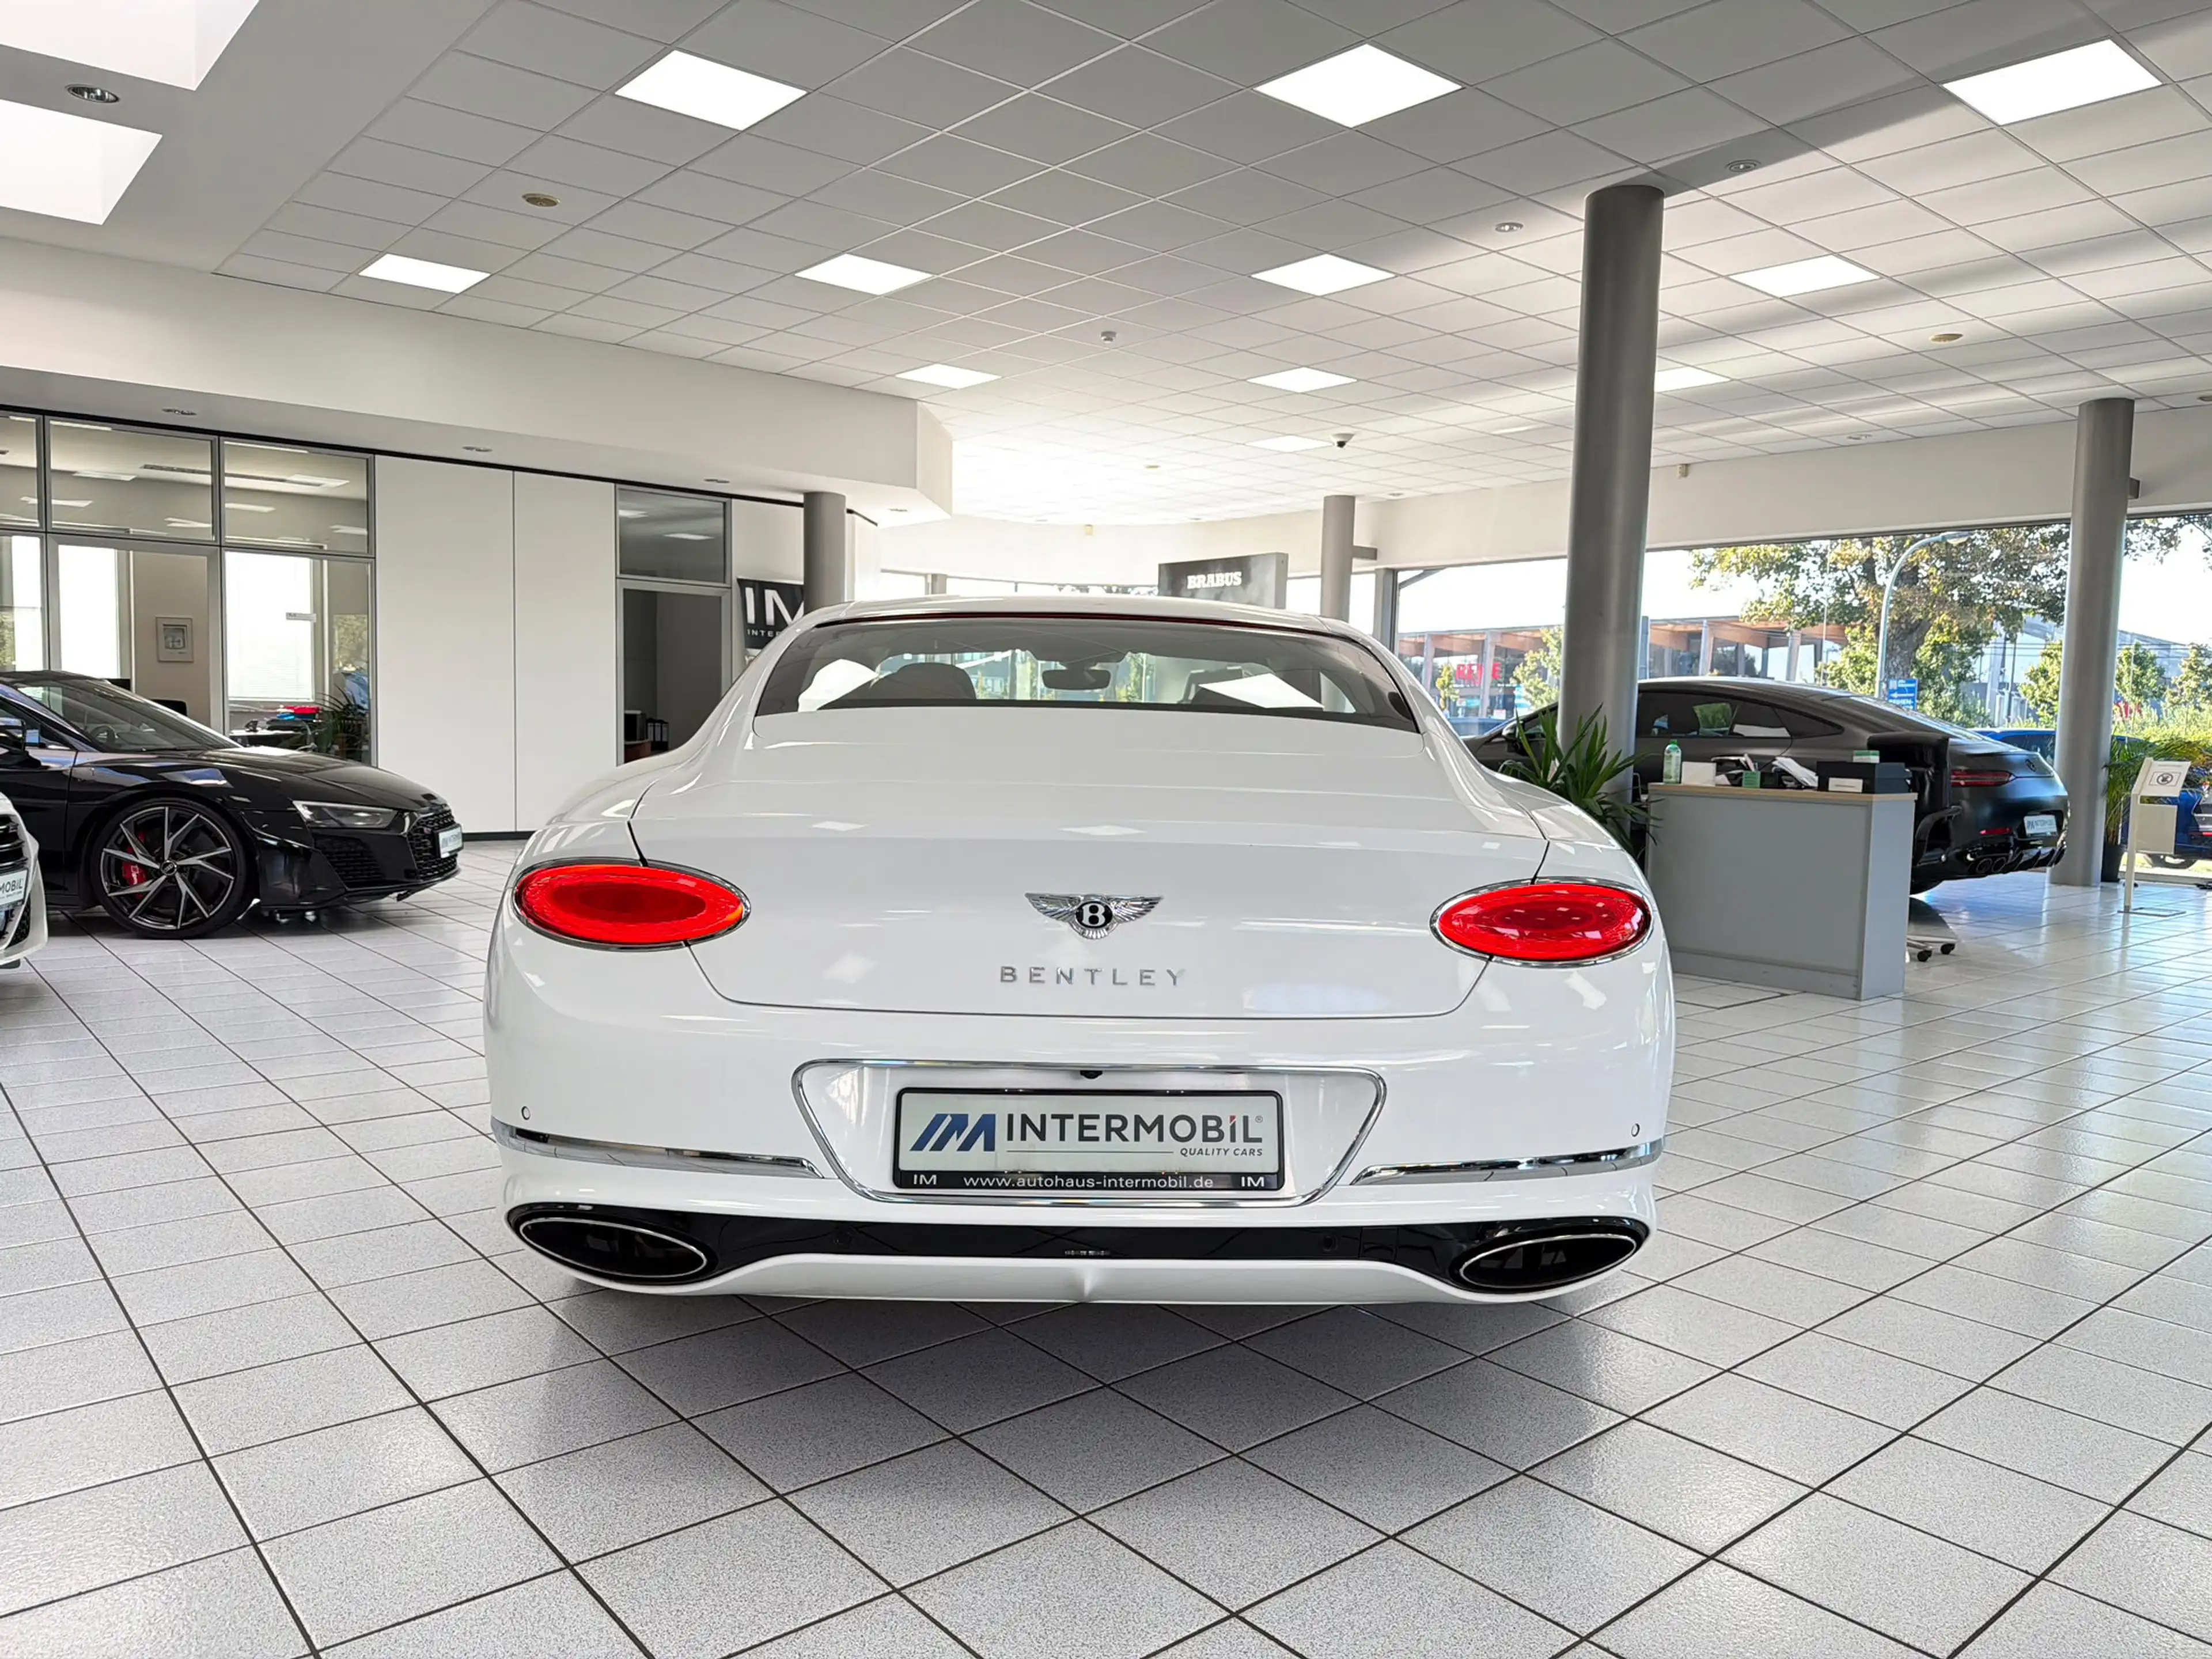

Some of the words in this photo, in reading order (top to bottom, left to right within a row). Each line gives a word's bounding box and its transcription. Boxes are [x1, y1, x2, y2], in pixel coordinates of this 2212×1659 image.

[1187, 571, 1242, 589] BRABUS
[1000, 965, 1185, 986] BENTLEY
[1180, 1147, 1230, 1157] QUALITY
[1233, 1147, 1263, 1157] CARS
[913, 1174, 937, 1185] IM
[963, 1174, 1214, 1188] www.autohaus-intermobil.de
[1241, 1176, 1265, 1187] IM
